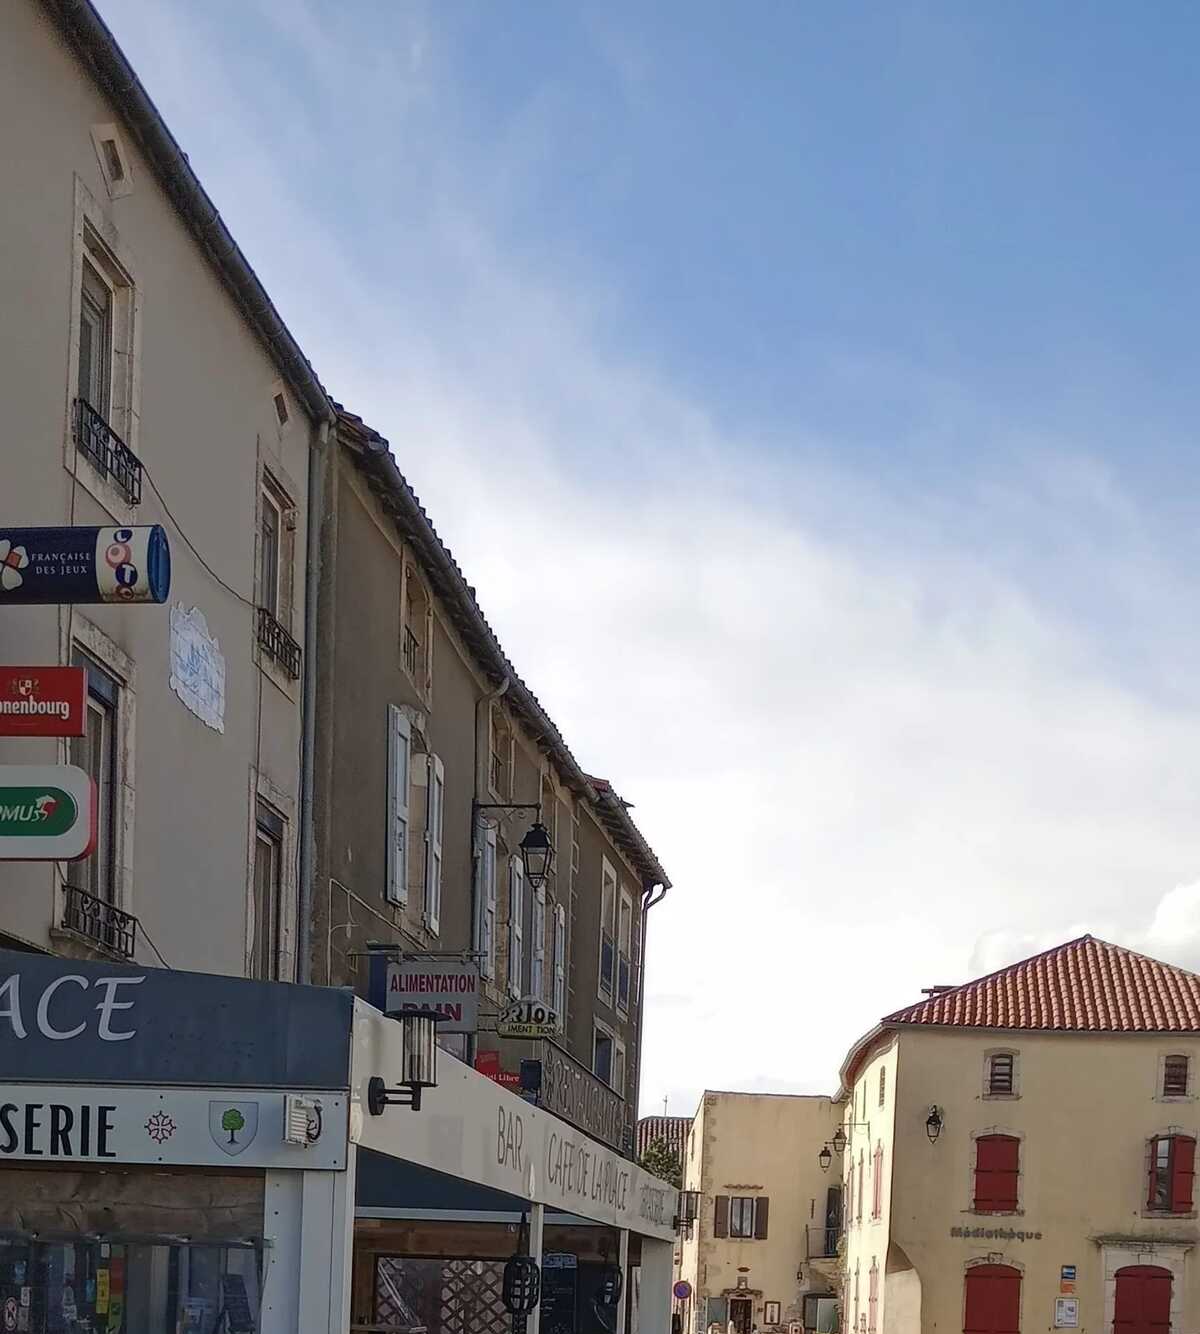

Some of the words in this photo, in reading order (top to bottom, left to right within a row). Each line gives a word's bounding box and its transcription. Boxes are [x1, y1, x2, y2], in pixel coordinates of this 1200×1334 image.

[31, 552, 91, 564] FRANÇAISE
[36, 566, 56, 575] DES
[60, 565, 88, 575] JEUX
[390, 974, 475, 992] ALIMENTATION
[0, 1103, 117, 1157] SERIE
[497, 1105, 523, 1172] BAR
[950, 1226, 1042, 1243] Médiathèque
